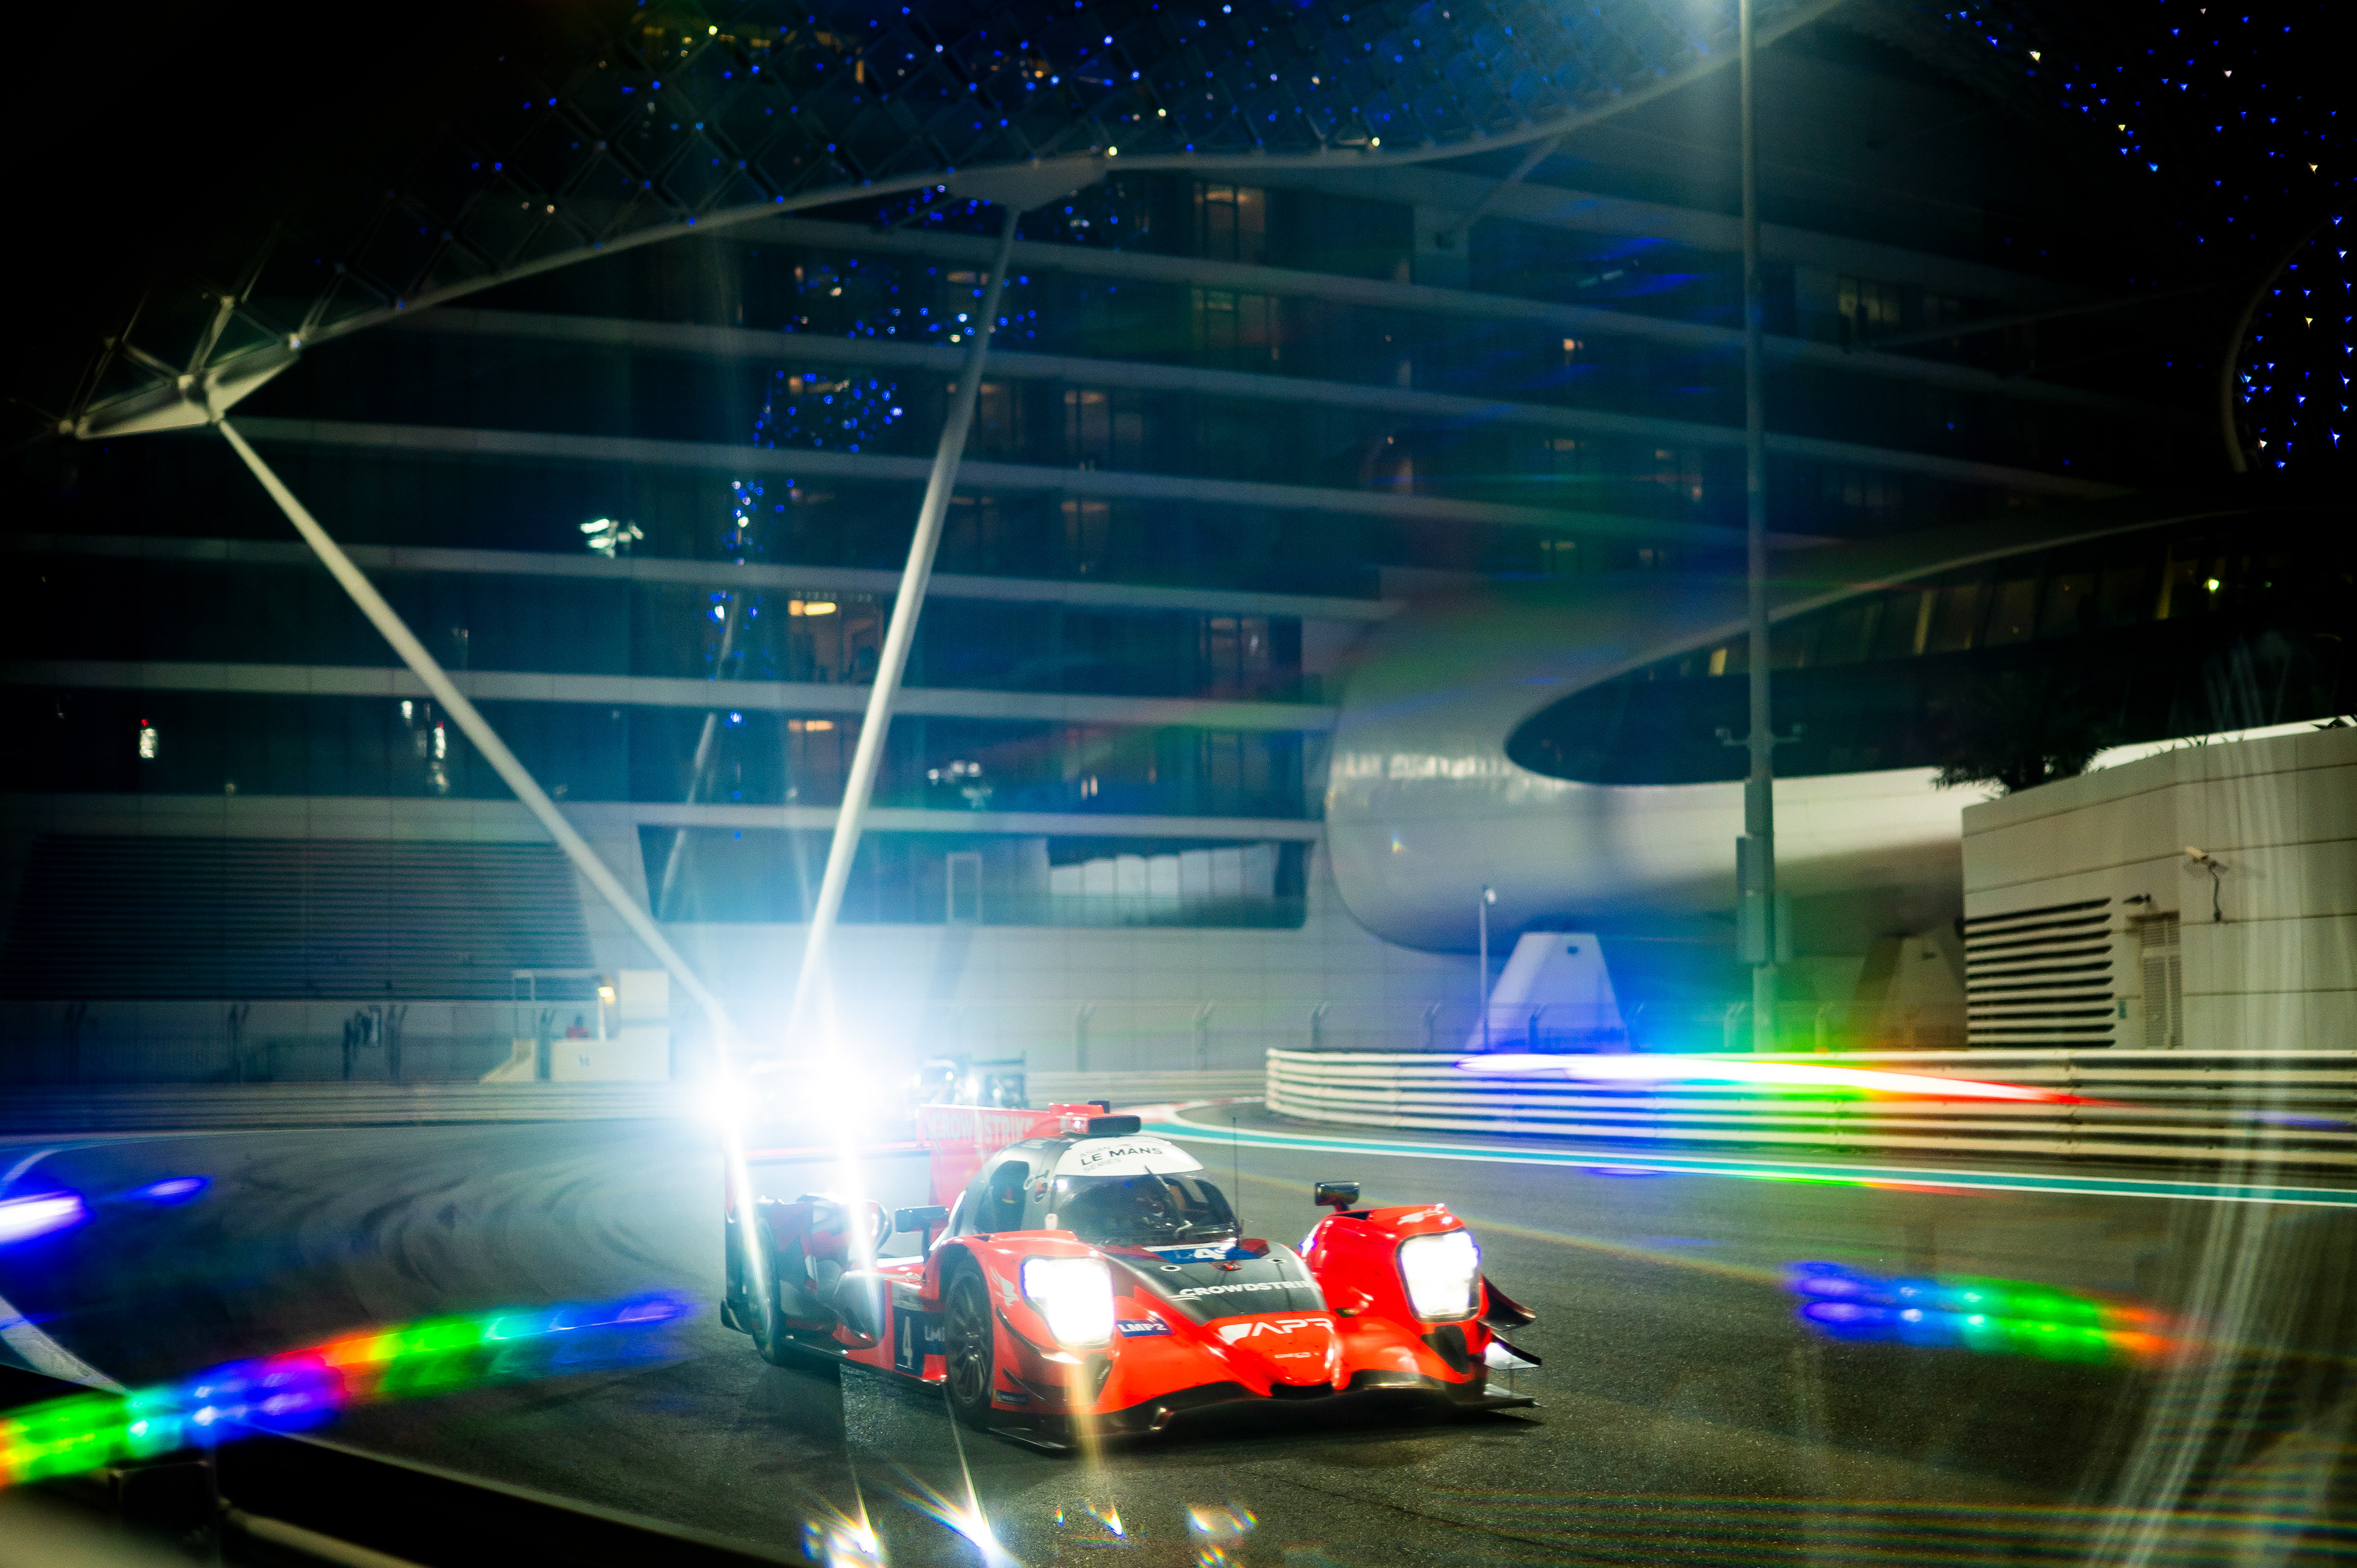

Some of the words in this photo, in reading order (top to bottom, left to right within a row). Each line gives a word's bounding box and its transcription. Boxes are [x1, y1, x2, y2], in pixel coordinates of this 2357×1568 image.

[1080, 1146, 1111, 1157] ASIAN
[1081, 1153, 1102, 1166] LE
[1109, 1147, 1163, 1157] MANS
[1083, 1157, 1122, 1173] SERIES
[1193, 1248, 1226, 1260] 4
[1179, 1280, 1321, 1296] CROWDSTRI
[1117, 1323, 1167, 1332] LMP2
[1251, 1318, 1335, 1337] APR
[902, 1316, 913, 1368] 4
